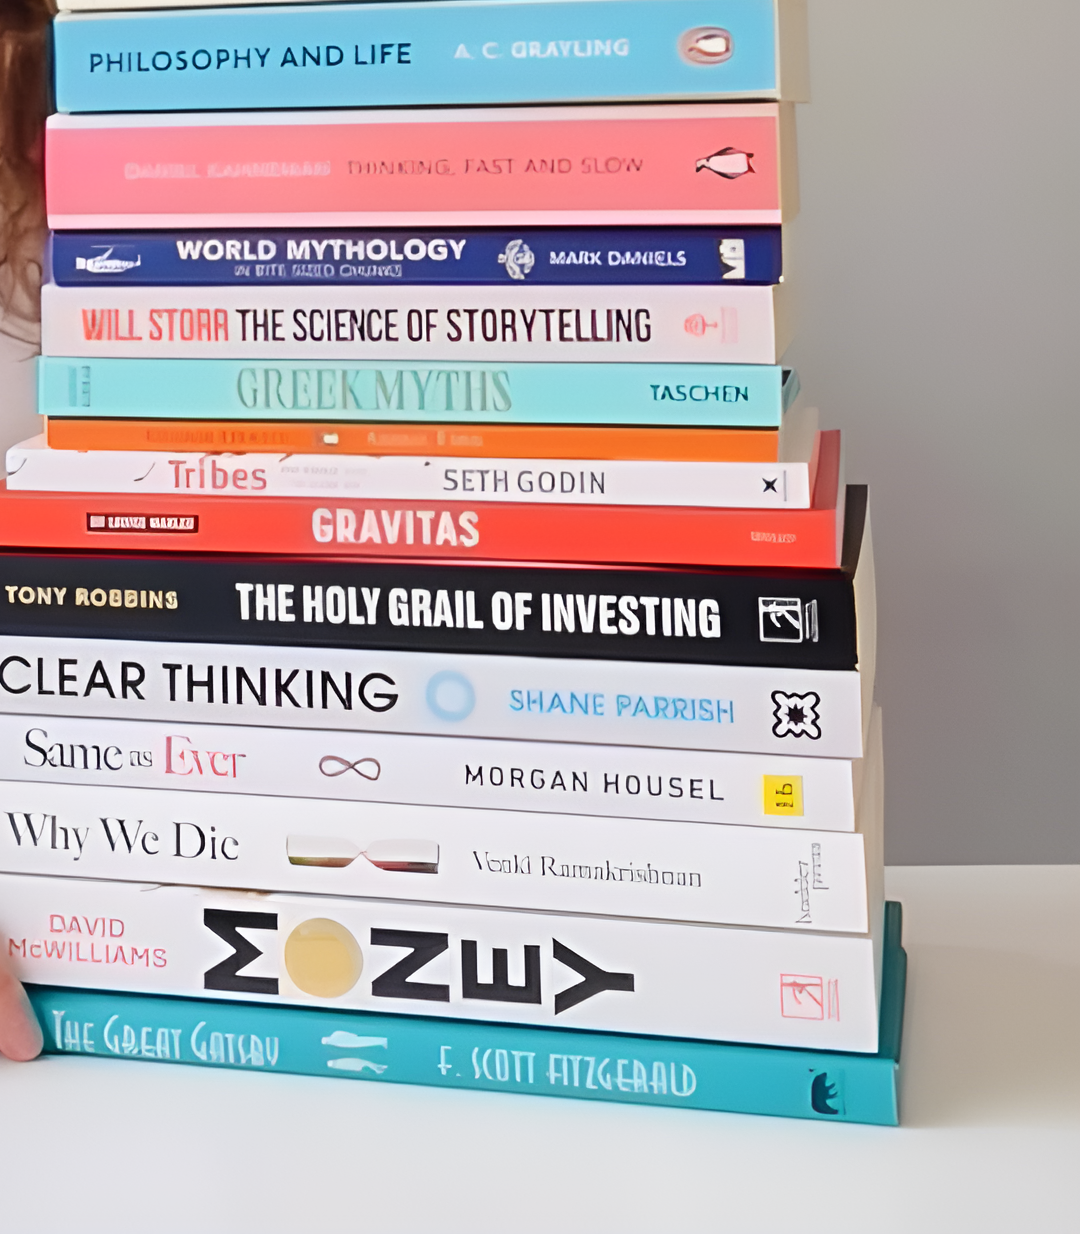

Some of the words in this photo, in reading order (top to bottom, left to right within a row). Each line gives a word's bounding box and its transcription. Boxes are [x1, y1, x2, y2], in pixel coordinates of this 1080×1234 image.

[89, 46, 271, 73] PHILOSOPHY
[280, 44, 344, 68] AND
[354, 42, 412, 66] LIFE
[511, 38, 630, 59] GRAYLING
[464, 157, 516, 175] FAST
[524, 157, 572, 175] AND
[581, 156, 644, 174] SLOW
[176, 239, 277, 261] WORLD
[287, 238, 467, 261] MYTHOLOGY
[549, 250, 602, 266] MARK
[608, 250, 687, 267] DANIELS
[81, 308, 143, 341] WILL
[149, 308, 229, 342] STORR
[235, 308, 285, 342] THE
[292, 308, 399, 343] SCIENCE
[406, 308, 439, 343] OF
[446, 308, 652, 343] STORYTELLING
[236, 367, 365, 412] GREEK
[373, 368, 512, 413] MYTHS
[649, 384, 749, 403] TASCHEN
[168, 459, 268, 491] Tribes
[442, 468, 509, 494] SETH
[516, 470, 606, 495] GODIN
[311, 507, 480, 548] GRAVITAS
[5, 585, 66, 606] TONY
[75, 587, 179, 610] ROBBINS
[235, 582, 296, 623] THE
[303, 584, 381, 626] HOLY
[388, 586, 484, 630] GRAIL
[491, 590, 533, 632] OF
[541, 592, 721, 639] INVESTING
[162, 662, 399, 713] THINKING
[509, 689, 605, 717] SHANE
[617, 694, 736, 725] PARRISH
[23, 727, 123, 771] Same
[129, 749, 153, 768] as
[164, 734, 247, 779] Ever
[465, 764, 589, 793] MORGAN
[603, 773, 725, 802] HOUSEL
[3, 810, 89, 861] Why
[98, 816, 160, 855] We
[173, 820, 240, 861] Die
[49, 914, 125, 938] DAVID
[8, 938, 168, 968] McWILLIAMS
[437, 1045, 461, 1078] F.
[471, 1046, 536, 1084] SCOTT
[546, 1053, 697, 1098] FITZGERALD
